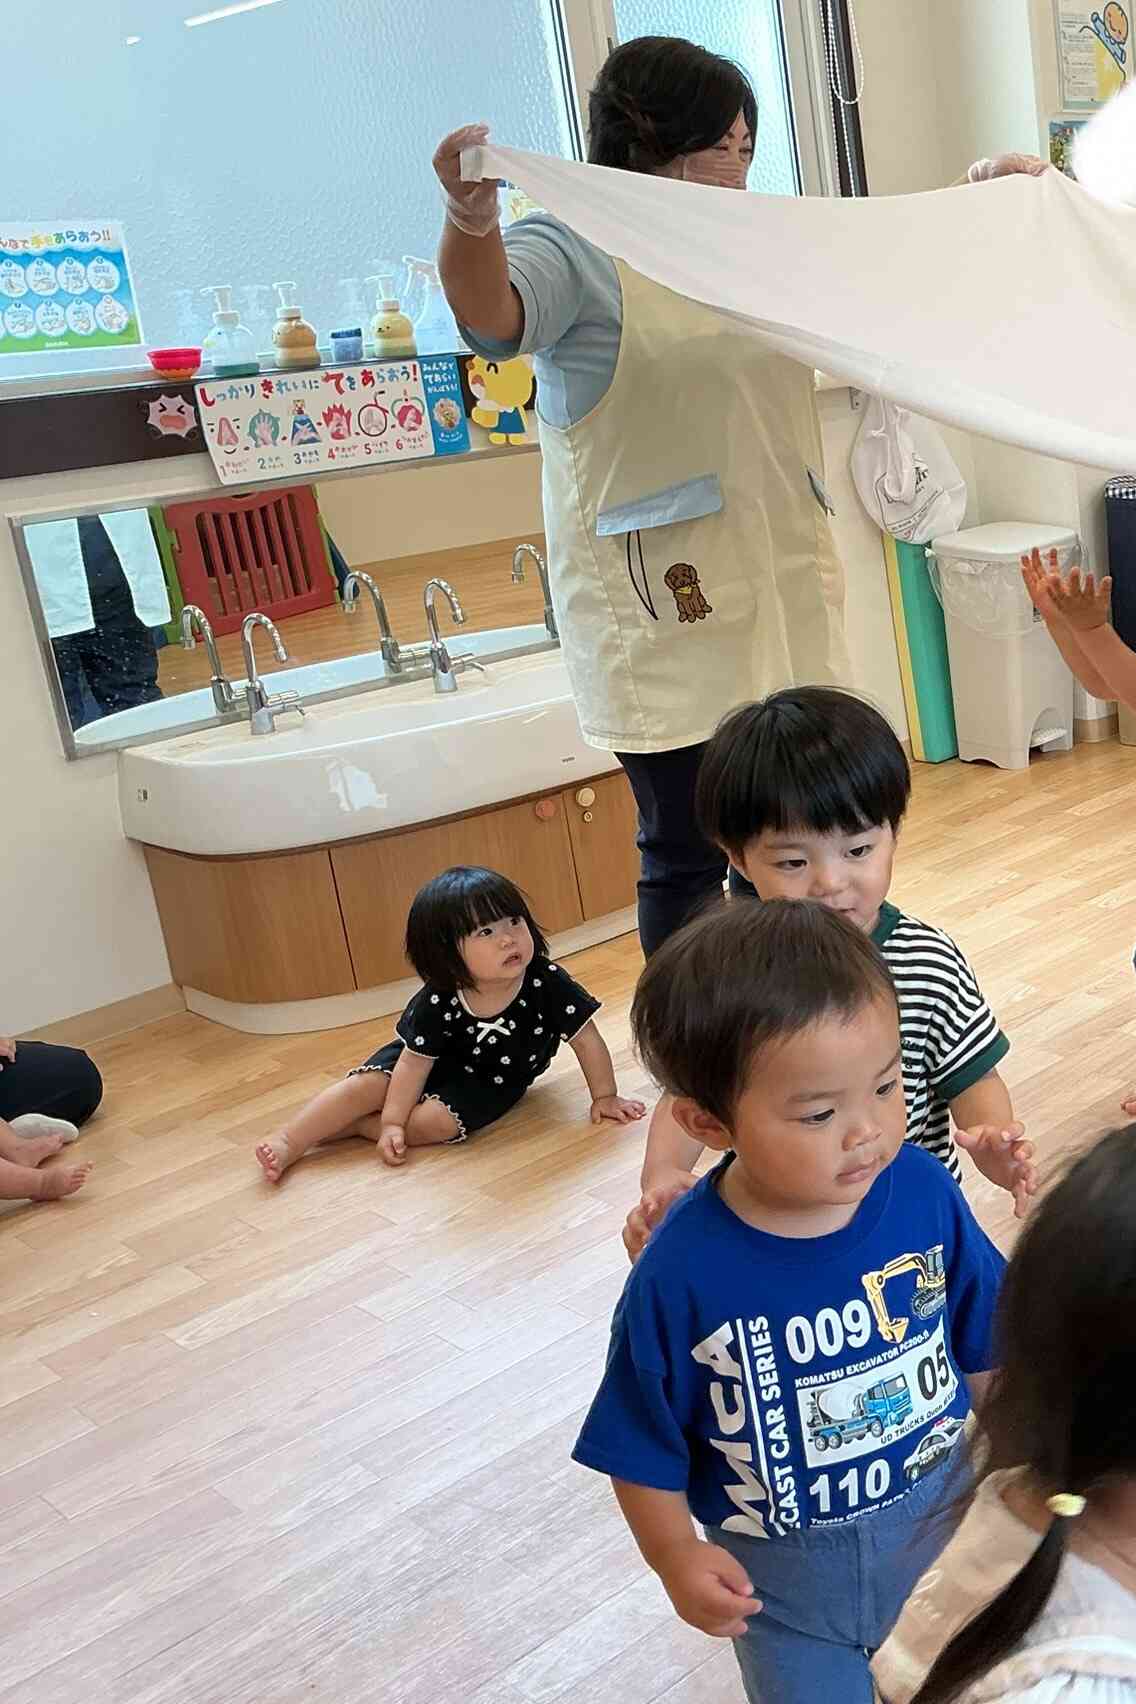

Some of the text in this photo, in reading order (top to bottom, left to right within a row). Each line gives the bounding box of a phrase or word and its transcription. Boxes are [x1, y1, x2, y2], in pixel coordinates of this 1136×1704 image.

[785, 1299, 872, 1364] 009
[794, 1367, 845, 1388] KOMATSU
[846, 1346, 901, 1375] EXCAVATOR
[917, 1341, 950, 1400] 05
[748, 1315, 800, 1529] CAST CAR SERIES
[880, 1433, 893, 1444] UD
[894, 1416, 925, 1437] TRUCKS
[809, 1458, 891, 1513] 110
